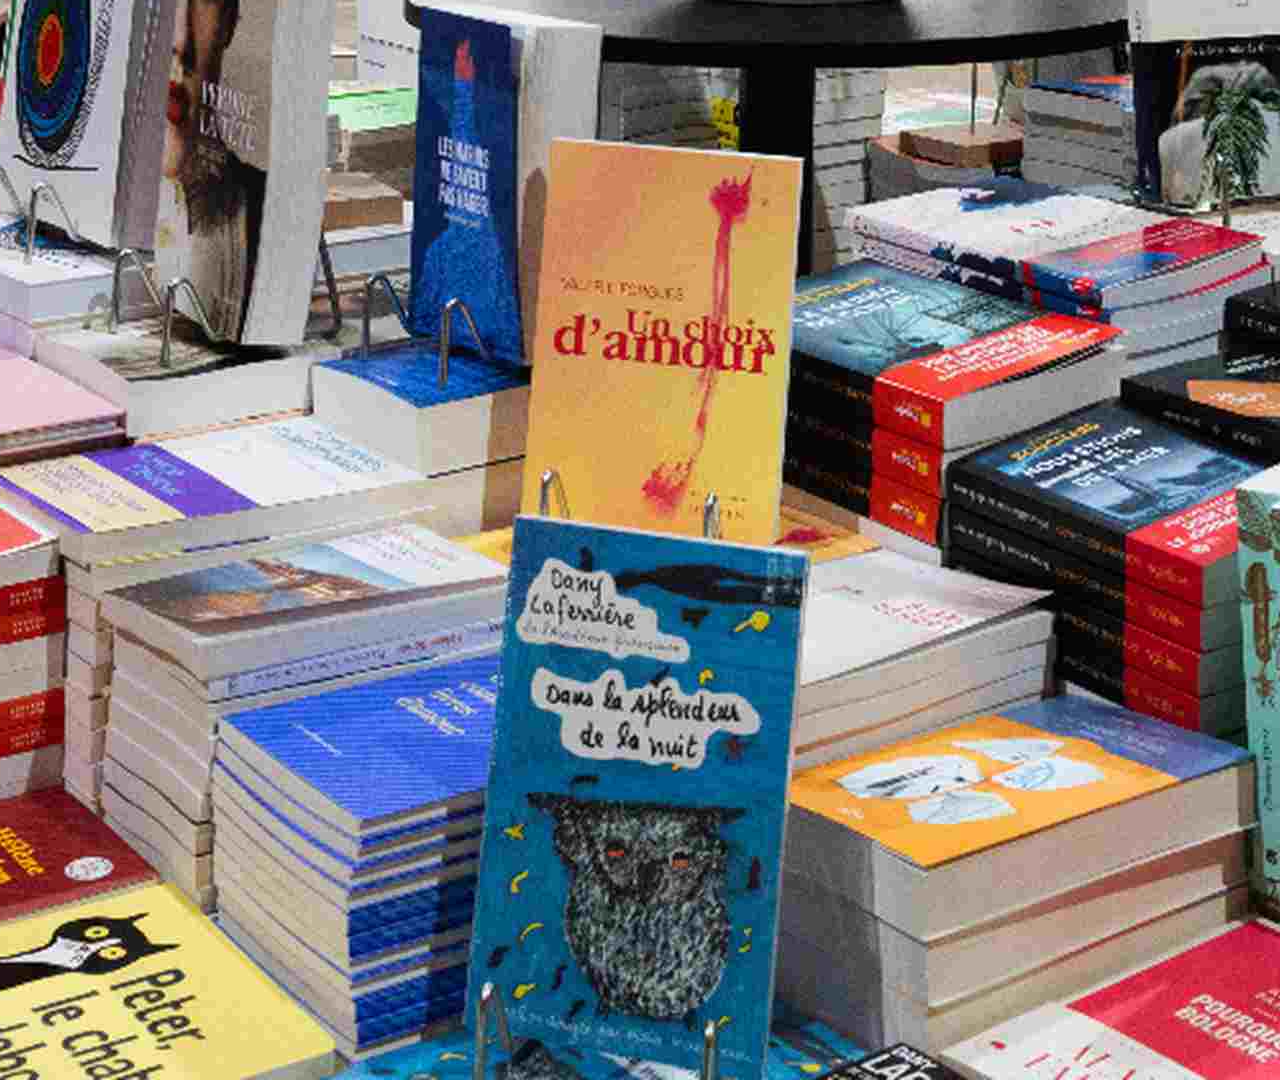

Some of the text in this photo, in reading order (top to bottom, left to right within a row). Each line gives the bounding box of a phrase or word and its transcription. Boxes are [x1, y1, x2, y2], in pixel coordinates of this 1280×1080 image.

[553, 313, 775, 374] d'amour
[625, 308, 775, 346] Un choix
[551, 569, 604, 608] Dany
[546, 680, 742, 727] Dans la splendeur
[580, 722, 700, 759] de la nuit
[31, 989, 100, 1027] le
[110, 967, 206, 1052] Peter,
[1173, 1004, 1280, 1065] BOLOGNE
